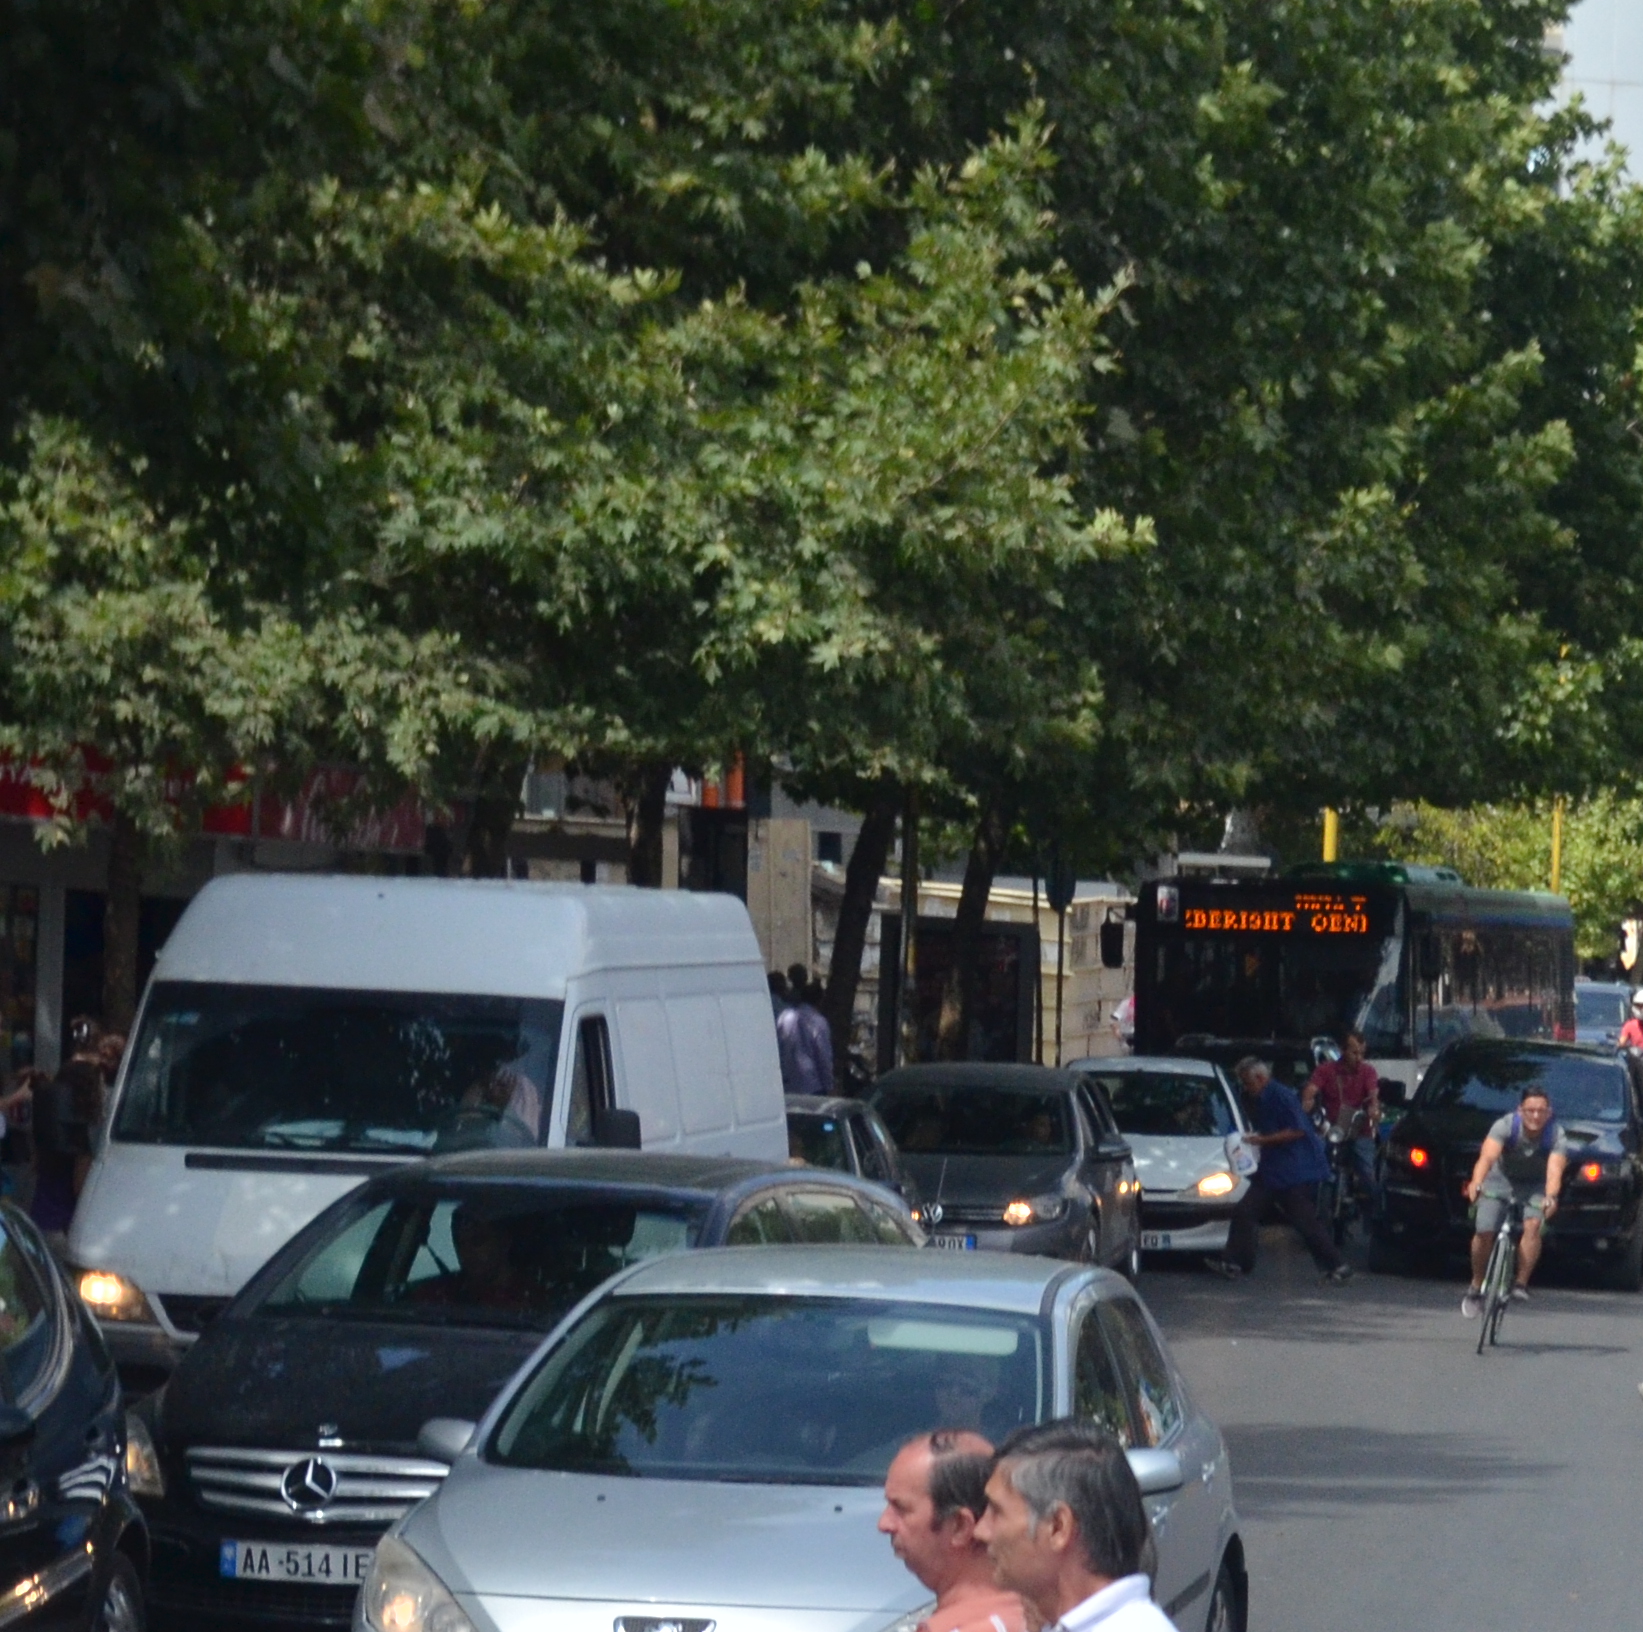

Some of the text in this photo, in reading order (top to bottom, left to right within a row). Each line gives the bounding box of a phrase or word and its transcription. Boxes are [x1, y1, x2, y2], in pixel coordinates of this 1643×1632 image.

[242, 1548, 370, 1580] AA 514 IE
